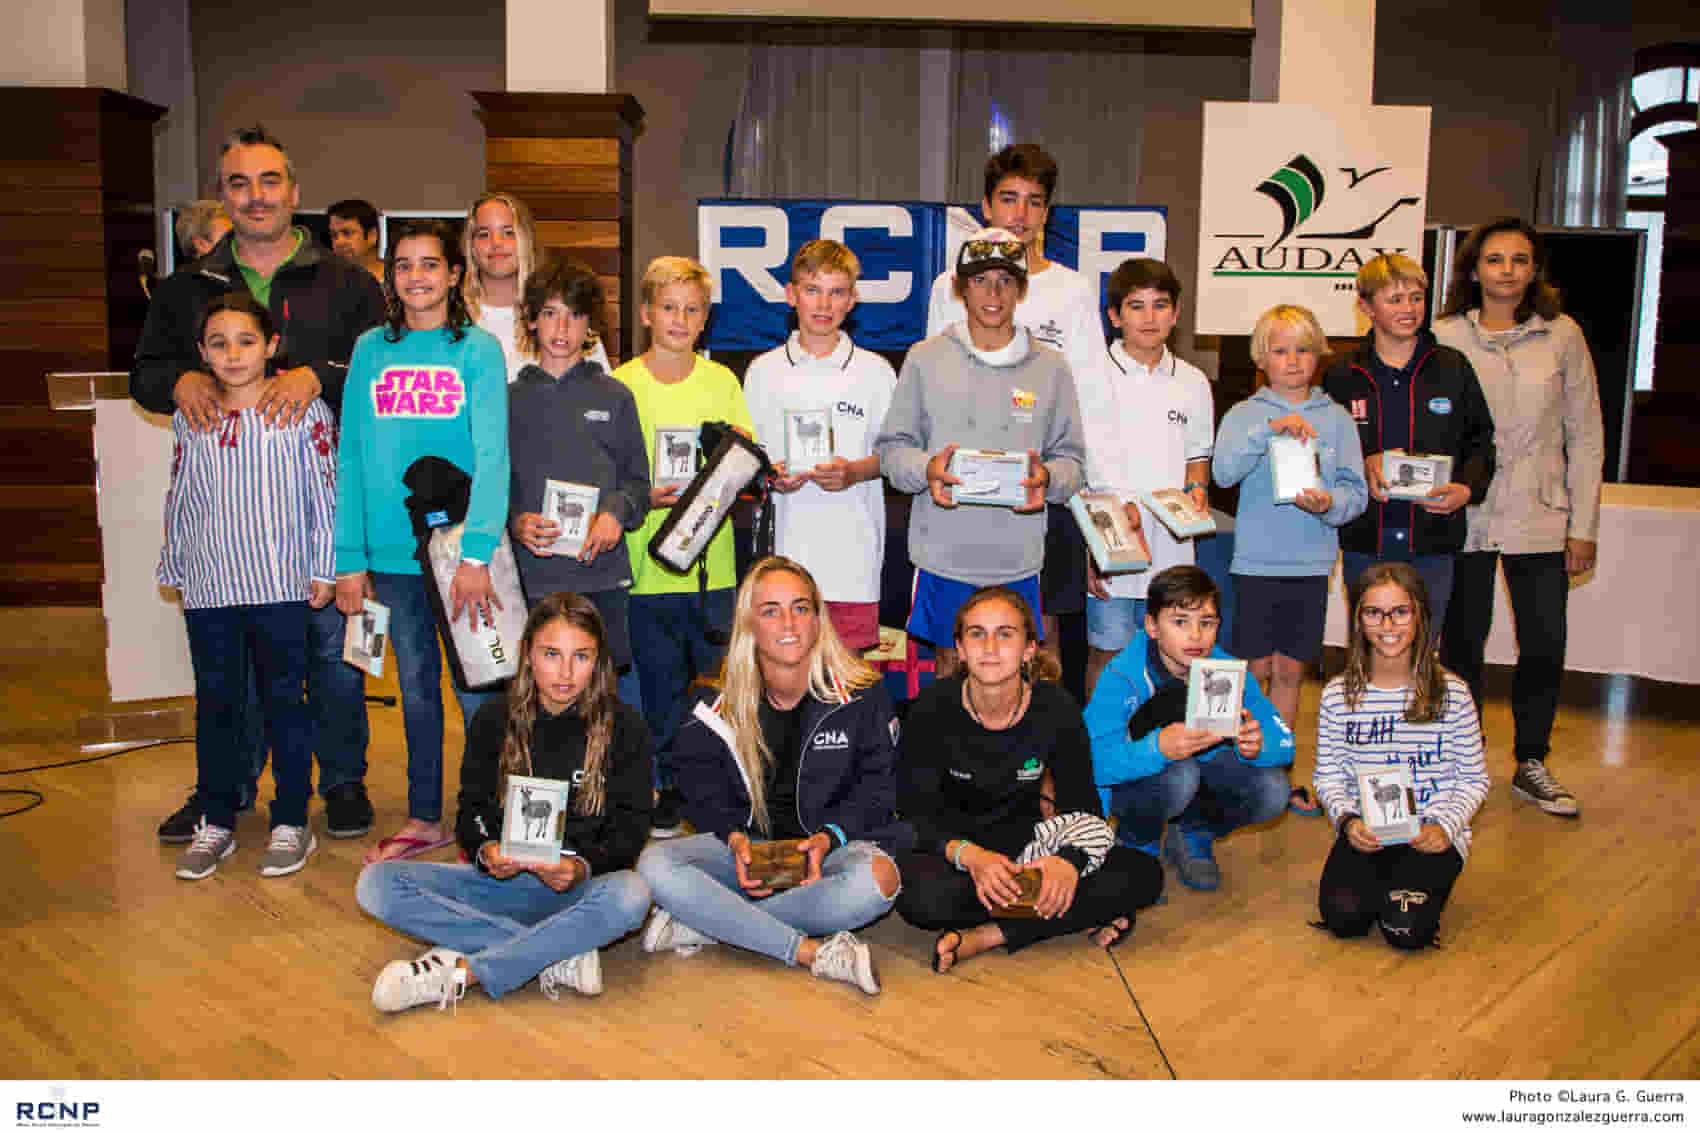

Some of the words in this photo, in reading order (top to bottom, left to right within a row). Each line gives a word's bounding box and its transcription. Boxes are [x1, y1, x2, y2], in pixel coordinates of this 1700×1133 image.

[698, 205, 1167, 303] RCP
[1212, 246, 1409, 271] AUDA
[375, 368, 464, 392] STAR
[376, 391, 464, 416] WARS
[814, 730, 849, 745] CNA
[1344, 715, 1395, 745] BLAH
